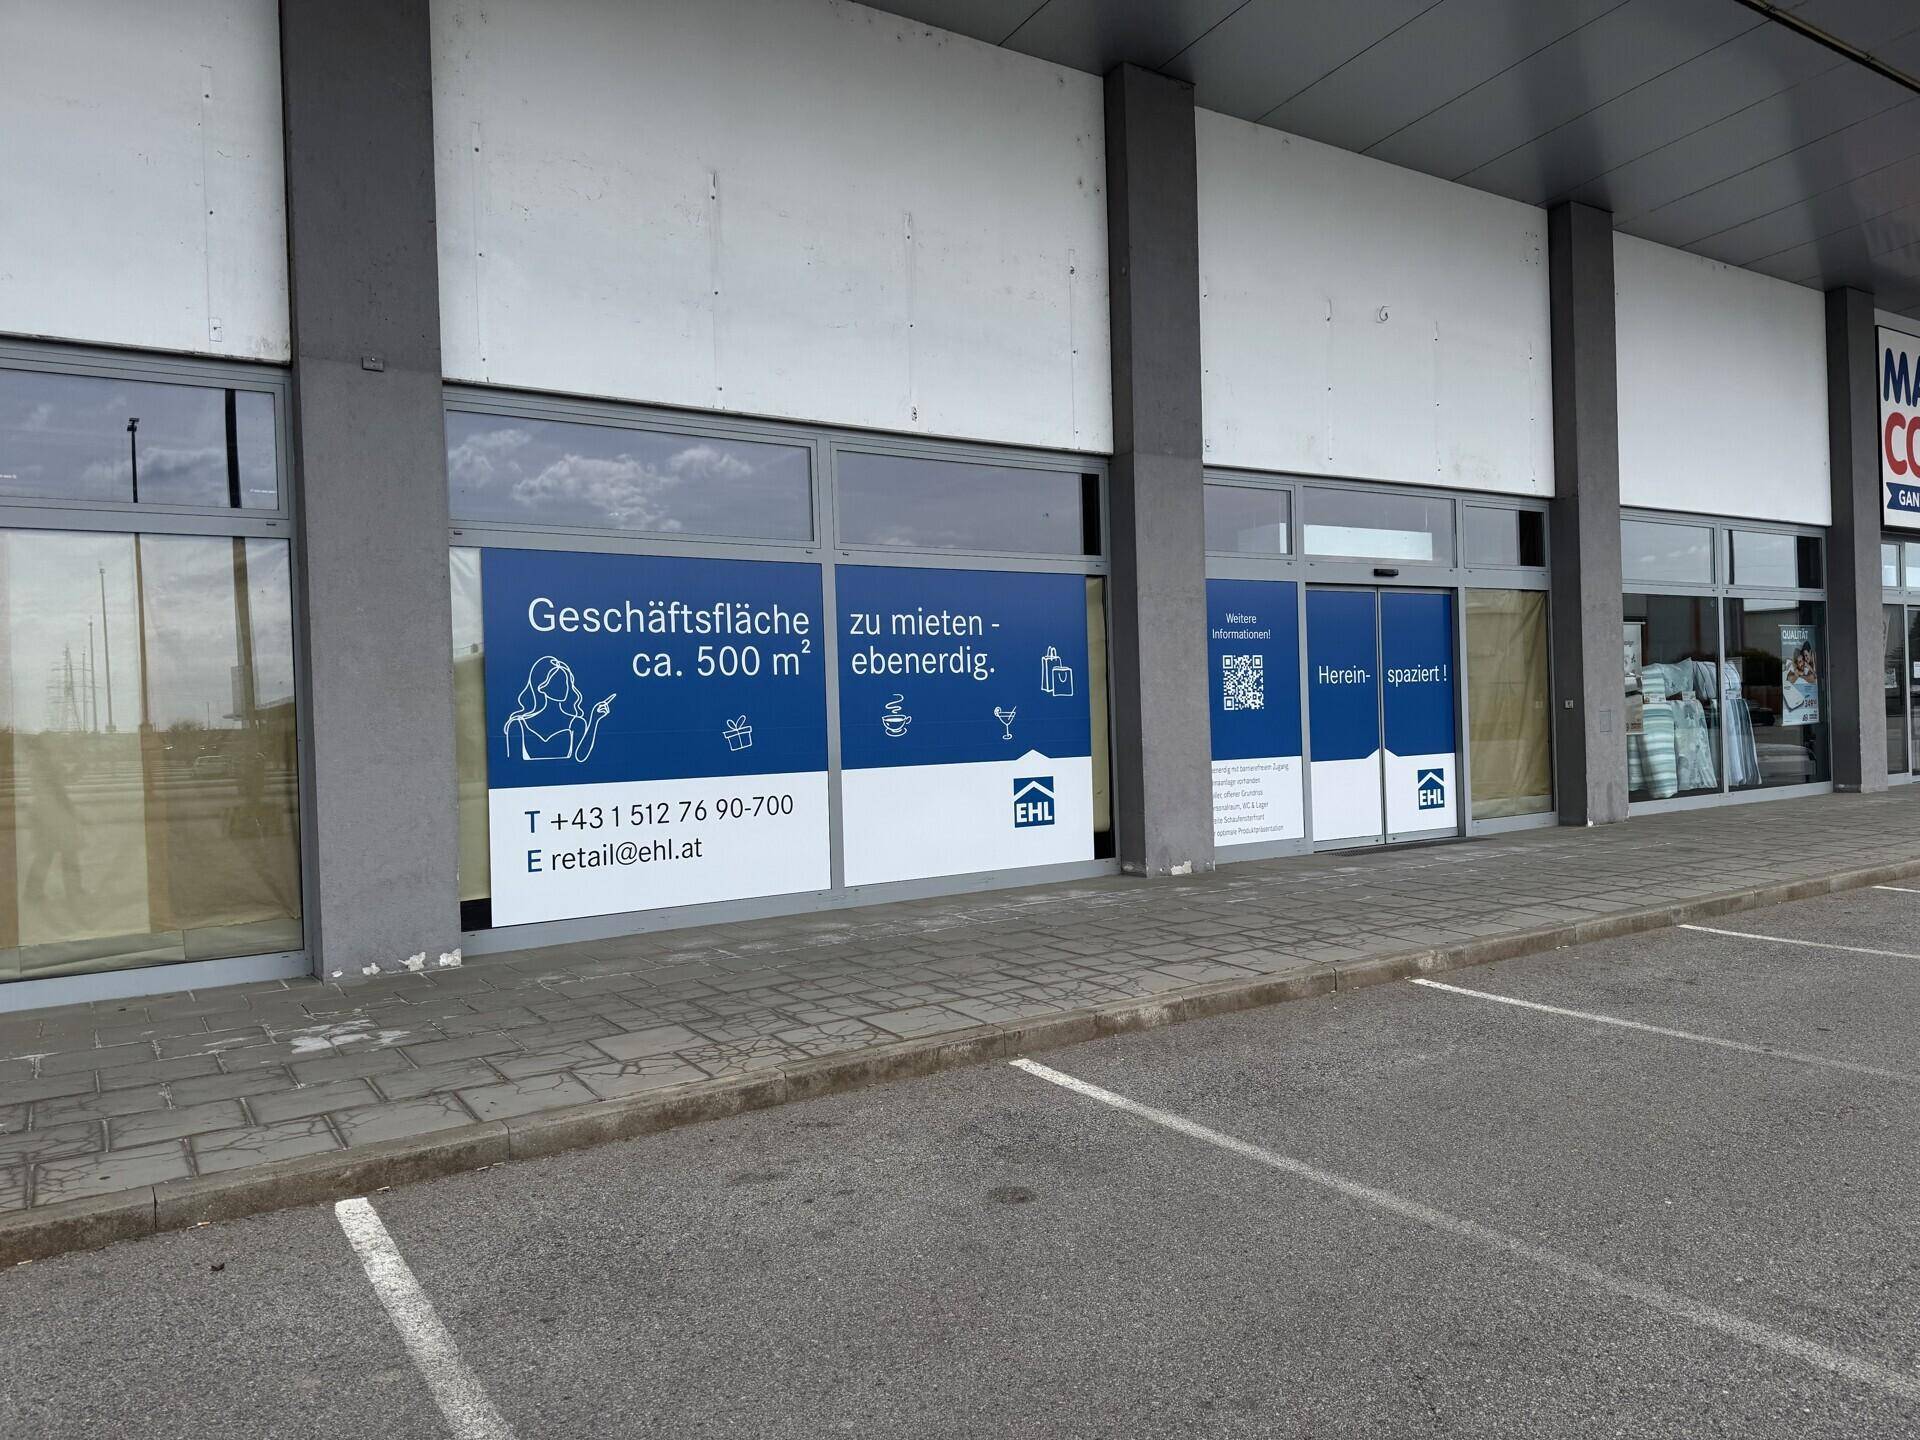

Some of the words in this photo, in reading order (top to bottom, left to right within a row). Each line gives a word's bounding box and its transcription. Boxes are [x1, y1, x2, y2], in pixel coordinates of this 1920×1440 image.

[528, 597, 810, 634] Geschäftsfläche
[850, 613, 880, 635] zu
[891, 607, 983, 636] mieten
[1226, 613, 1257, 624] Weitere
[1212, 628, 1271, 640] Informationen!
[1782, 628, 1808, 640] QUALITÄT
[632, 652, 683, 677] ca.
[697, 645, 760, 677] 500
[772, 639, 811, 676] m²
[851, 645, 995, 681] ebenerdig.
[1318, 665, 1370, 684] Herein-
[1387, 664, 1440, 687] spaziert
[1256, 801, 1269, 810] Lager
[1419, 788, 1444, 806] EHL
[525, 810, 541, 833] T
[550, 807, 604, 831] +43
[611, 805, 620, 827] 1
[630, 802, 670, 826] 512
[678, 799, 707, 822] 76
[716, 794, 794, 820] 90-700
[1016, 801, 1053, 823] EHL
[527, 849, 543, 872] E
[551, 838, 702, 871] retail@ehl.at
